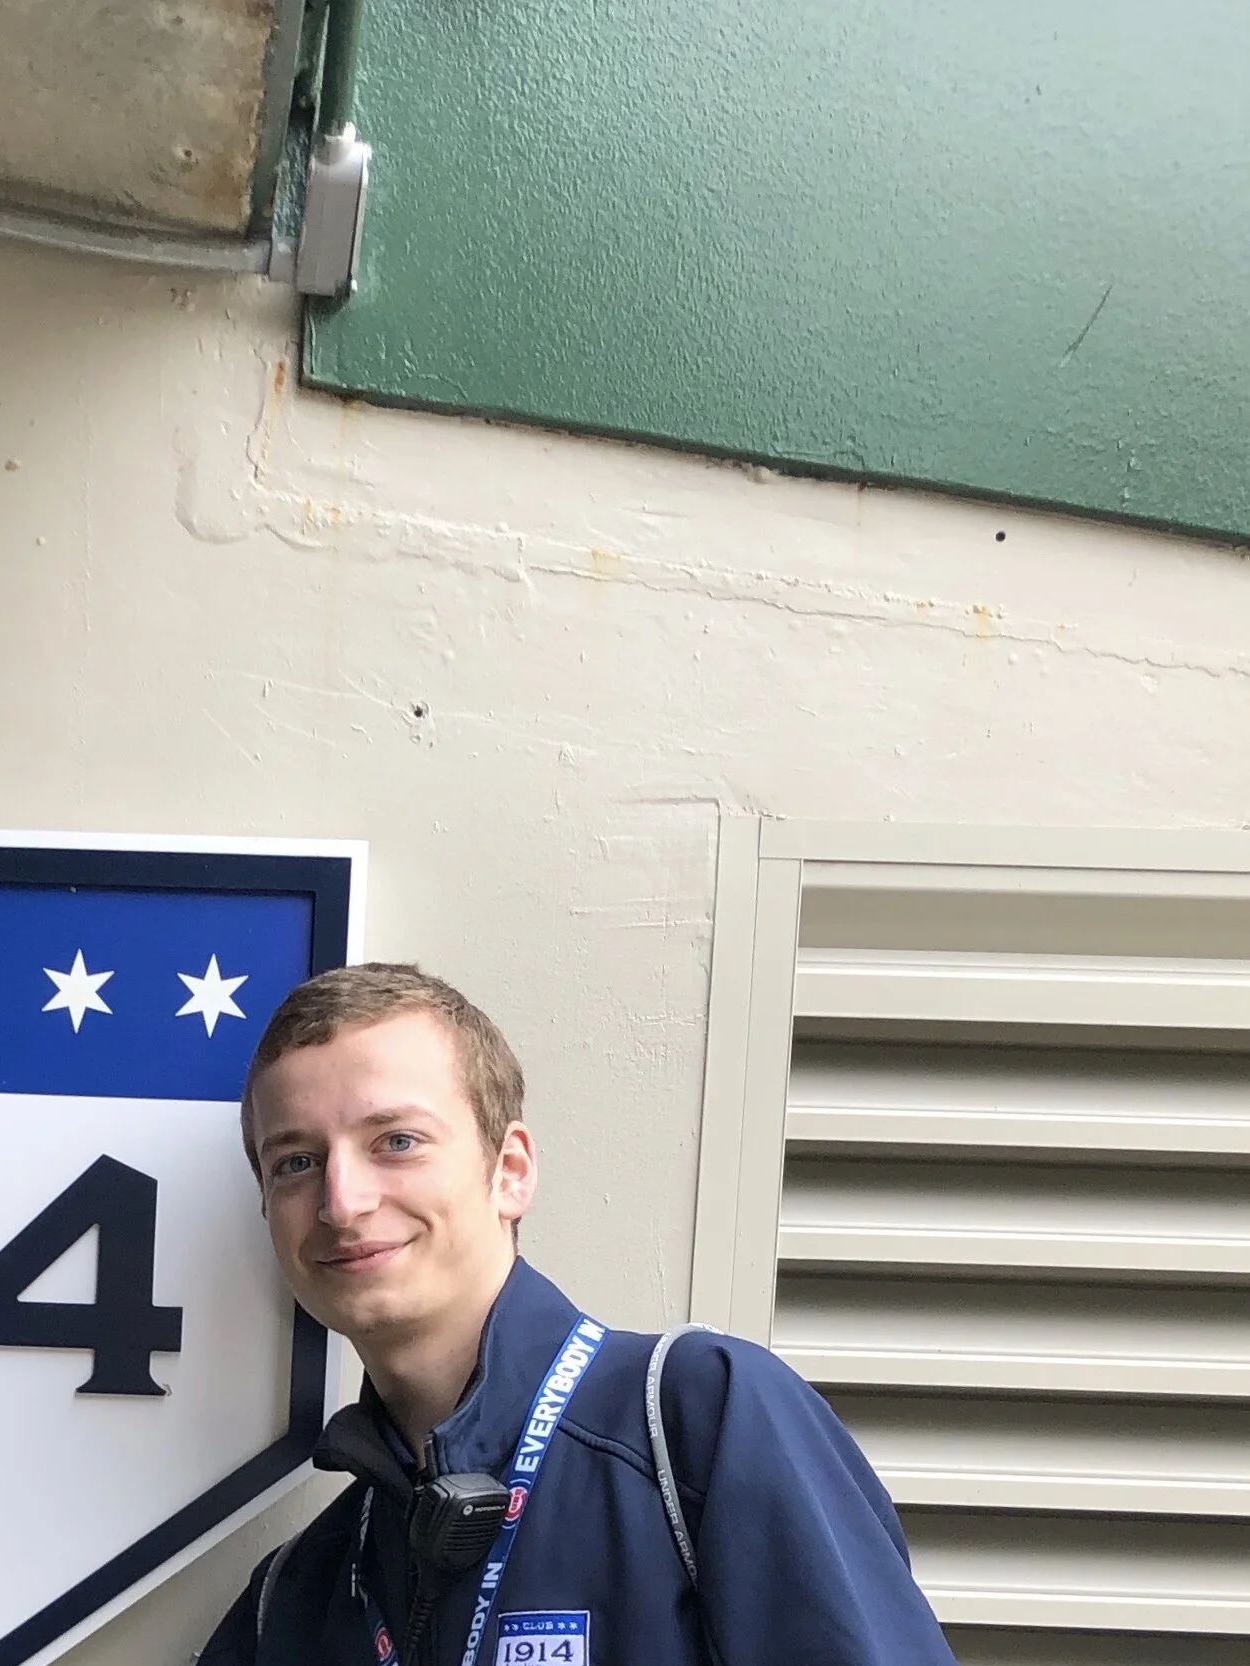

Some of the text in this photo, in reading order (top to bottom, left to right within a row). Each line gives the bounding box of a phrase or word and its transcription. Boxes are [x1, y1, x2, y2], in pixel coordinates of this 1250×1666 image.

[515, 1334, 595, 1473] EVERYBODY
[645, 1375, 658, 1438] ARMOUR
[657, 1469, 679, 1525] UNDER
[481, 1562, 503, 1589] IN
[522, 1621, 554, 1631] CLUB
[503, 1640, 574, 1663] 1914
